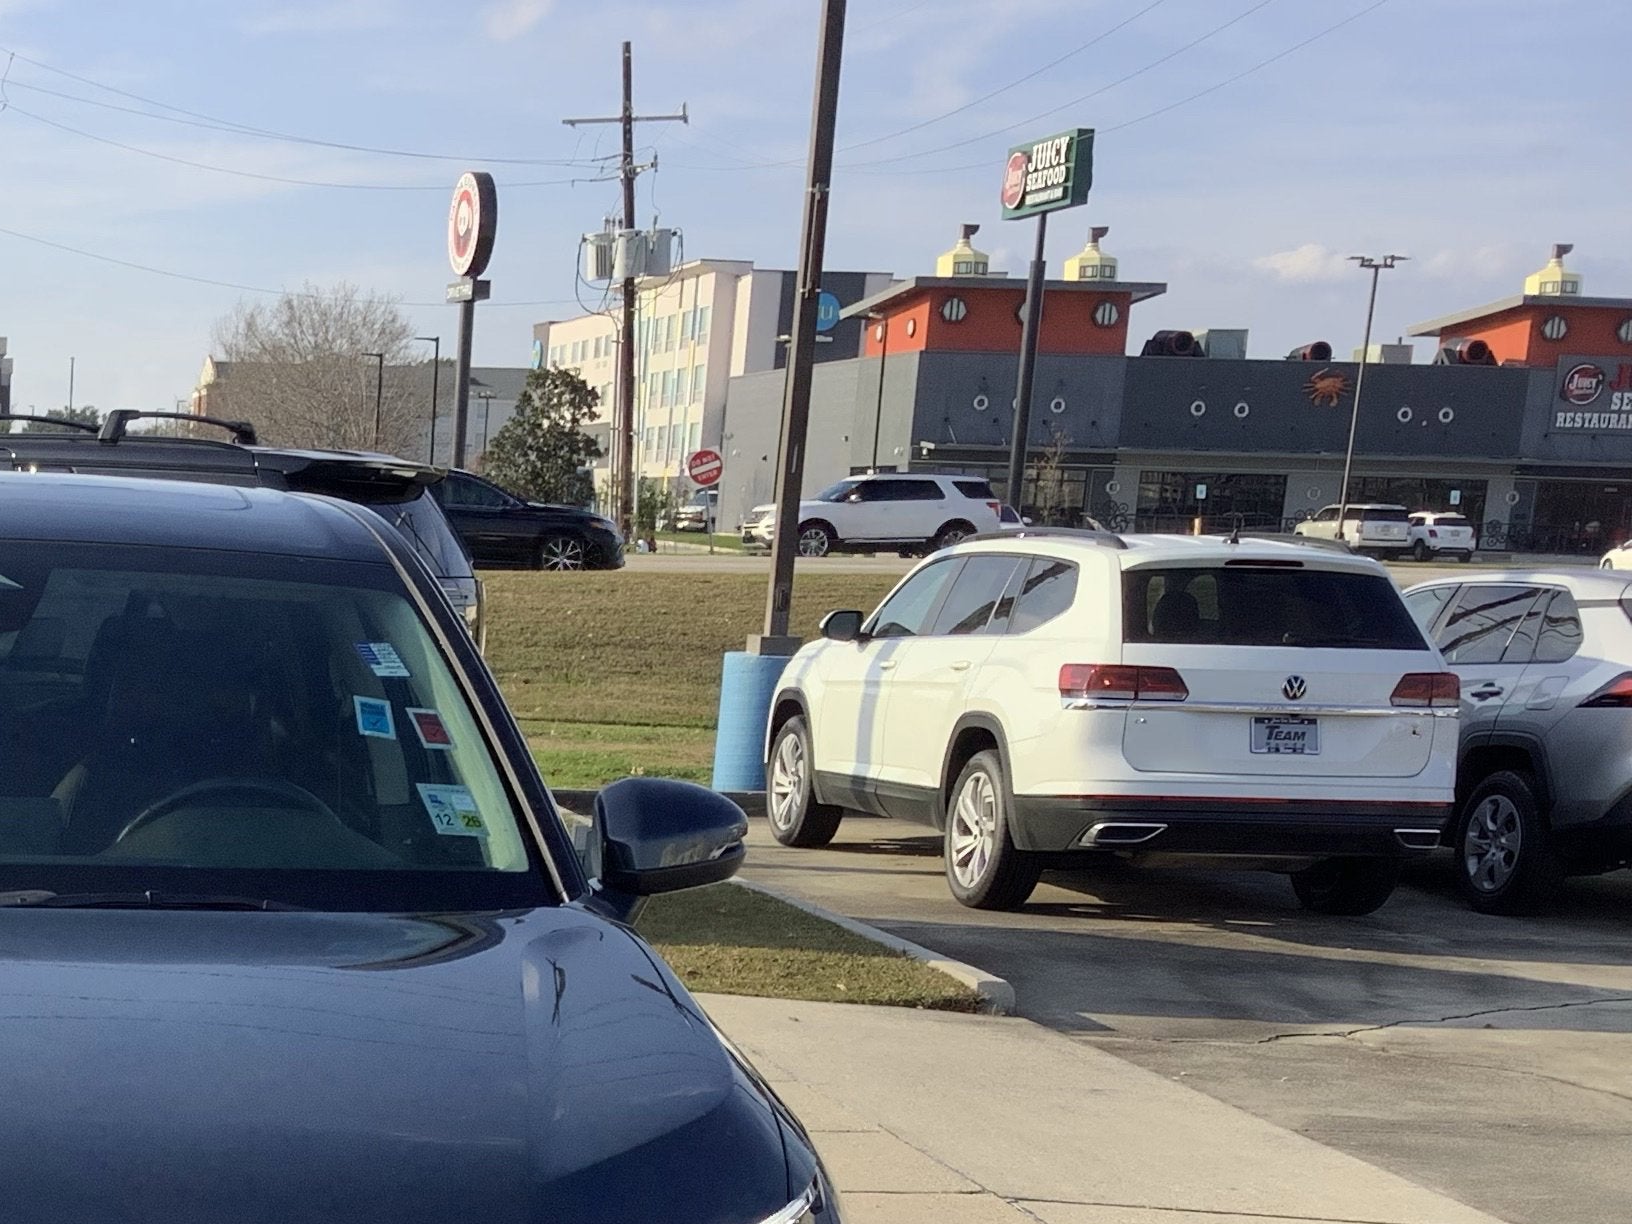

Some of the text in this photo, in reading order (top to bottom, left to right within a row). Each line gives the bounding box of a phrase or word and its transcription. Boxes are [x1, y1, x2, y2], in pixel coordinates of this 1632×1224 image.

[1028, 136, 1070, 172] JUICY
[1026, 165, 1066, 191] SEAFOOD
[691, 453, 716, 467] DO NOT
[697, 469, 718, 481] ENTER
[1265, 725, 1306, 742] TEAM
[435, 813, 455, 826] 12
